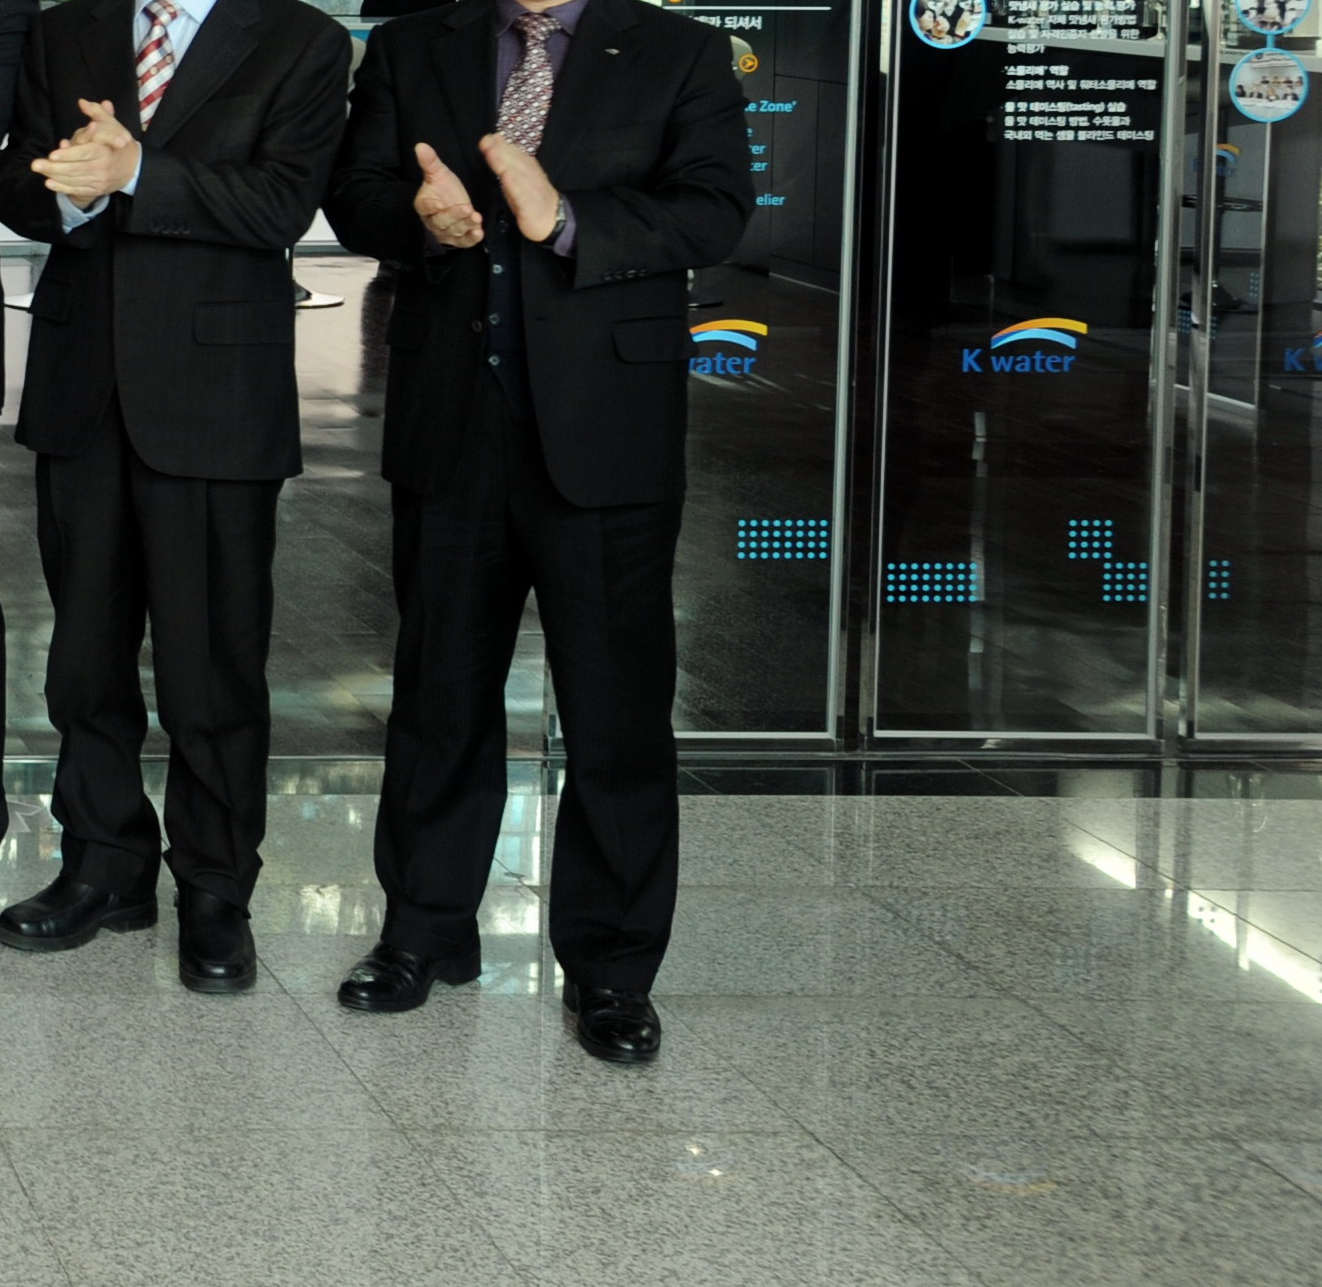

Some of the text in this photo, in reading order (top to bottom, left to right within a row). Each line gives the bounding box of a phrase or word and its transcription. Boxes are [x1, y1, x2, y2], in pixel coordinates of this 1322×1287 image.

[756, 194, 786, 205] elier
[962, 349, 1076, 373] K water
[1284, 348, 1306, 371] K
